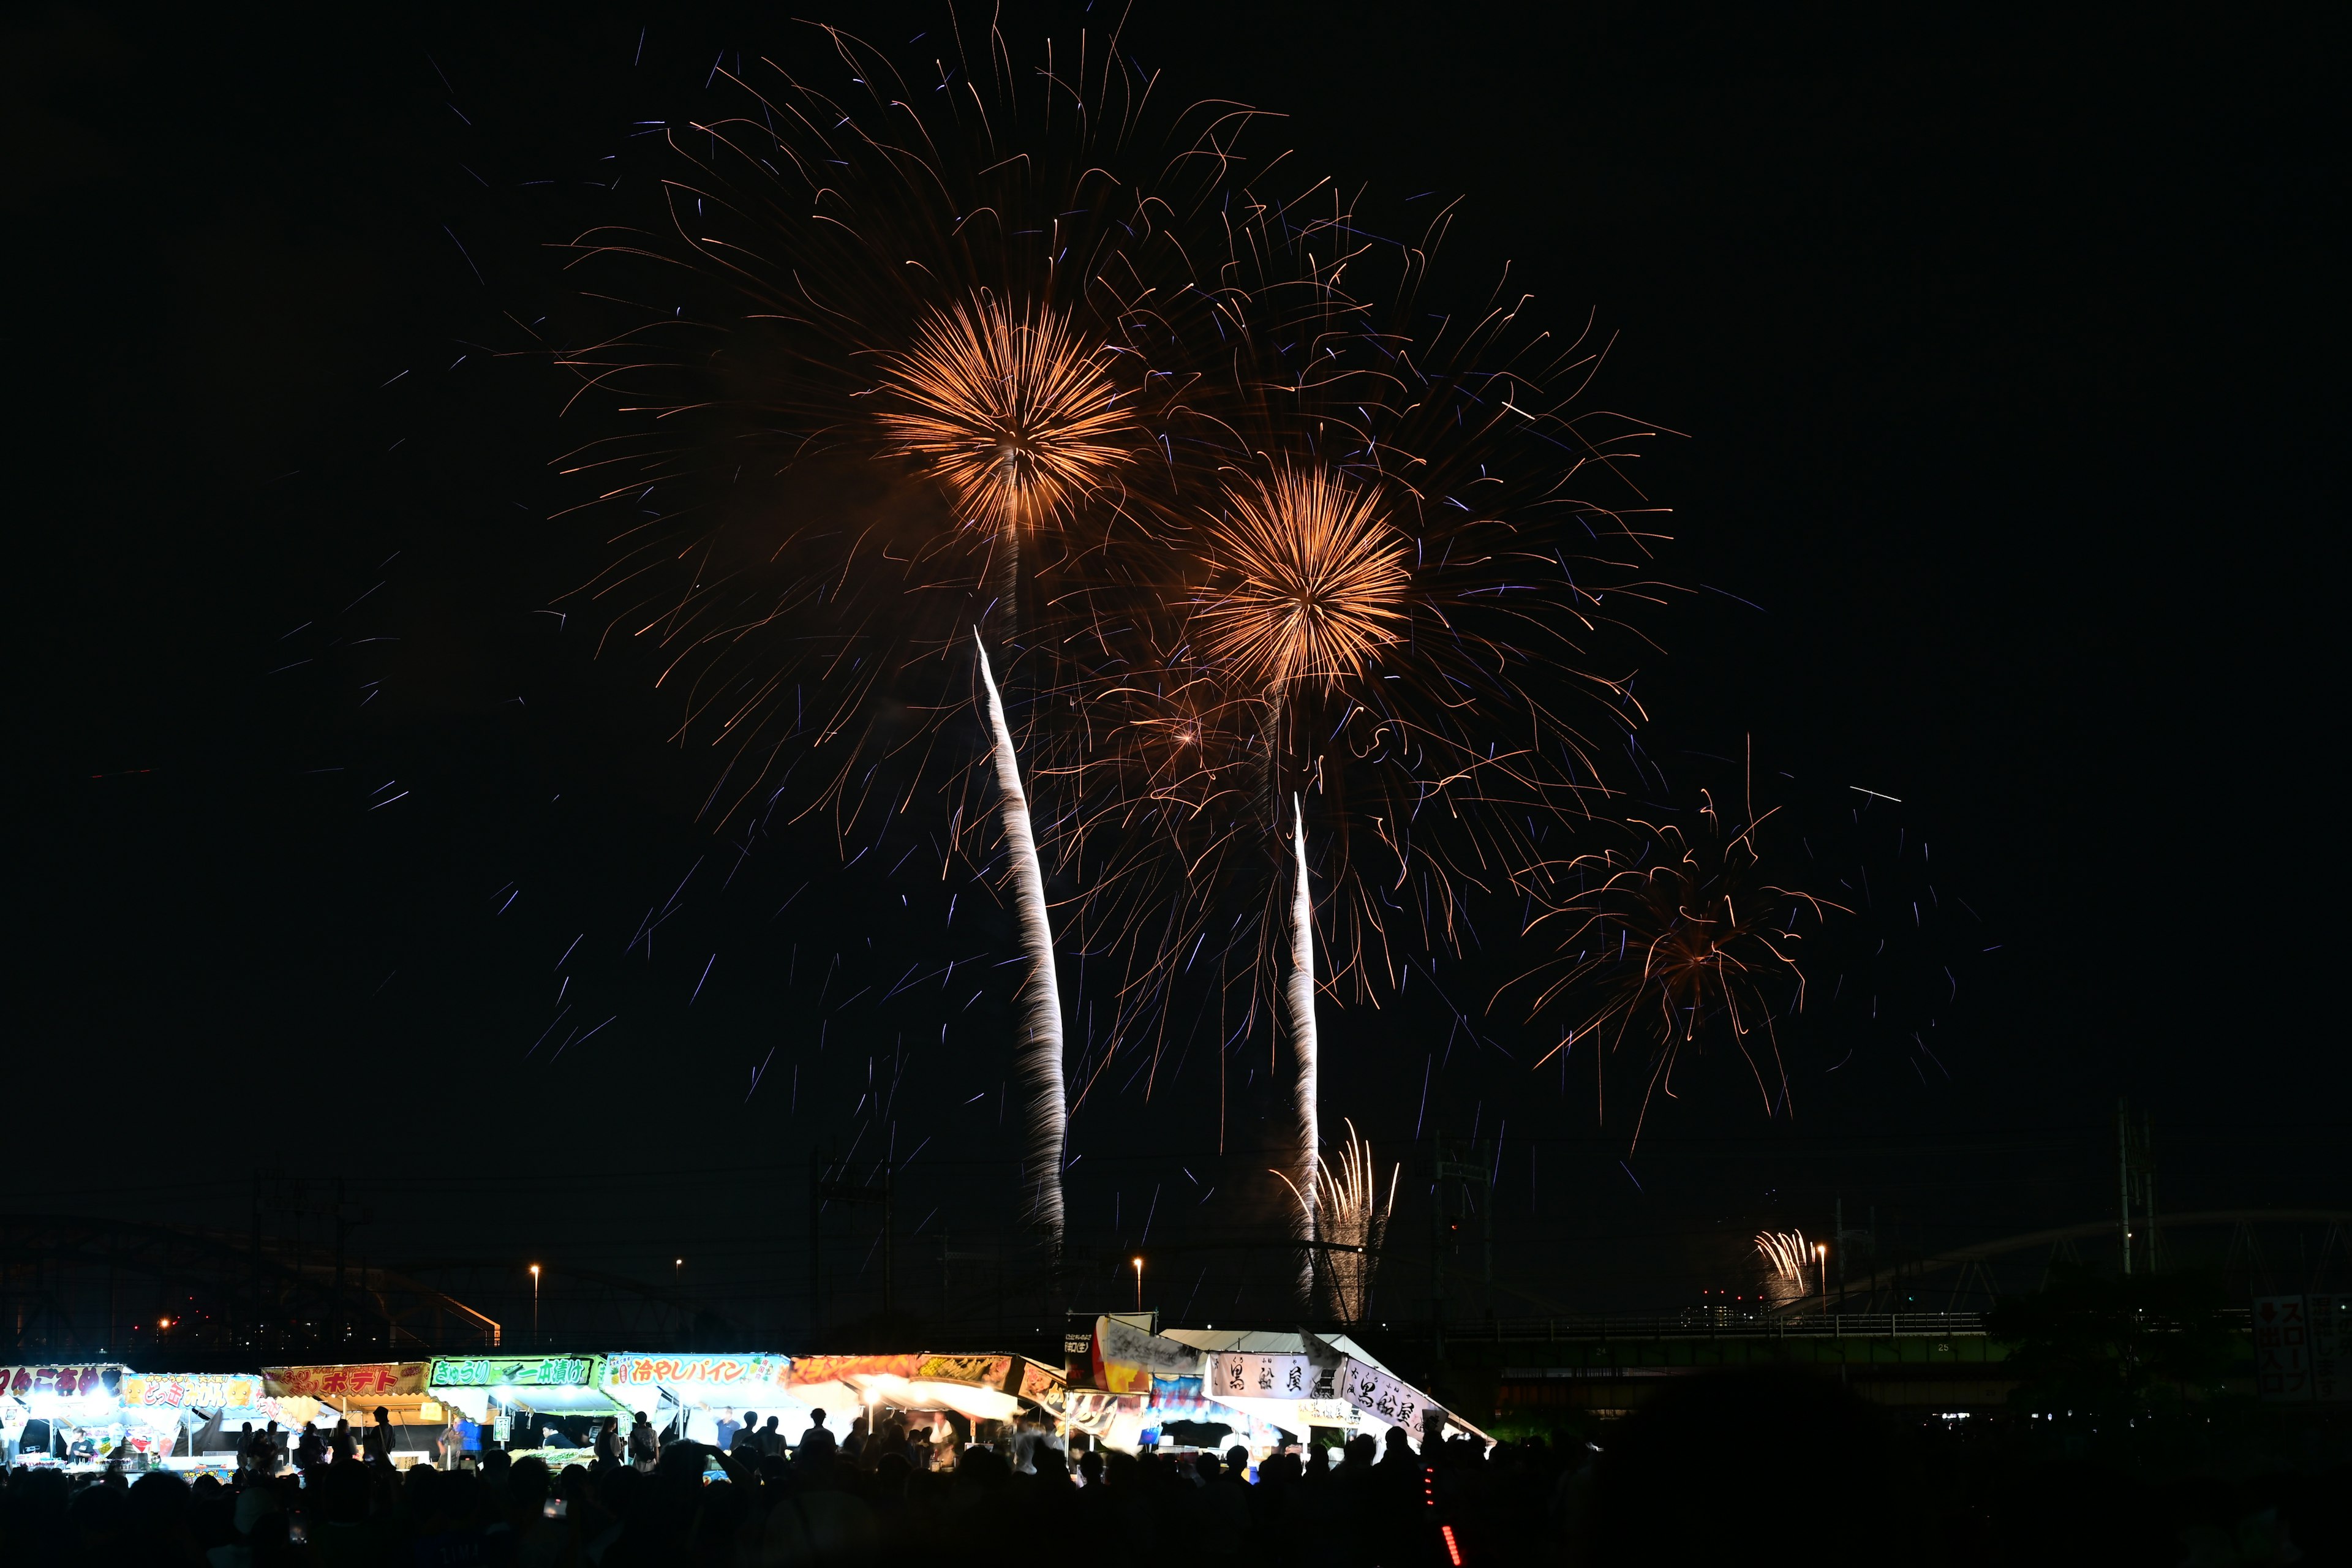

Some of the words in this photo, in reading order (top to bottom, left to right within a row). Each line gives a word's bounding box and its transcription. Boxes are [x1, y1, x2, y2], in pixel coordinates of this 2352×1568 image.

[2259, 1327, 2284, 1393] 出入口
[2282, 1303, 2308, 1392] スロープ
[320, 1370, 399, 1394] ポテト
[435, 1360, 491, 1385] きゅうり
[518, 1359, 584, 1384] 一本漬け
[632, 1359, 746, 1382] 冷やしパイン
[1229, 1363, 1302, 1392] 黒船屋
[143, 1382, 227, 1408] どっ缶みかん
[1358, 1378, 1415, 1427] 黒船屋
